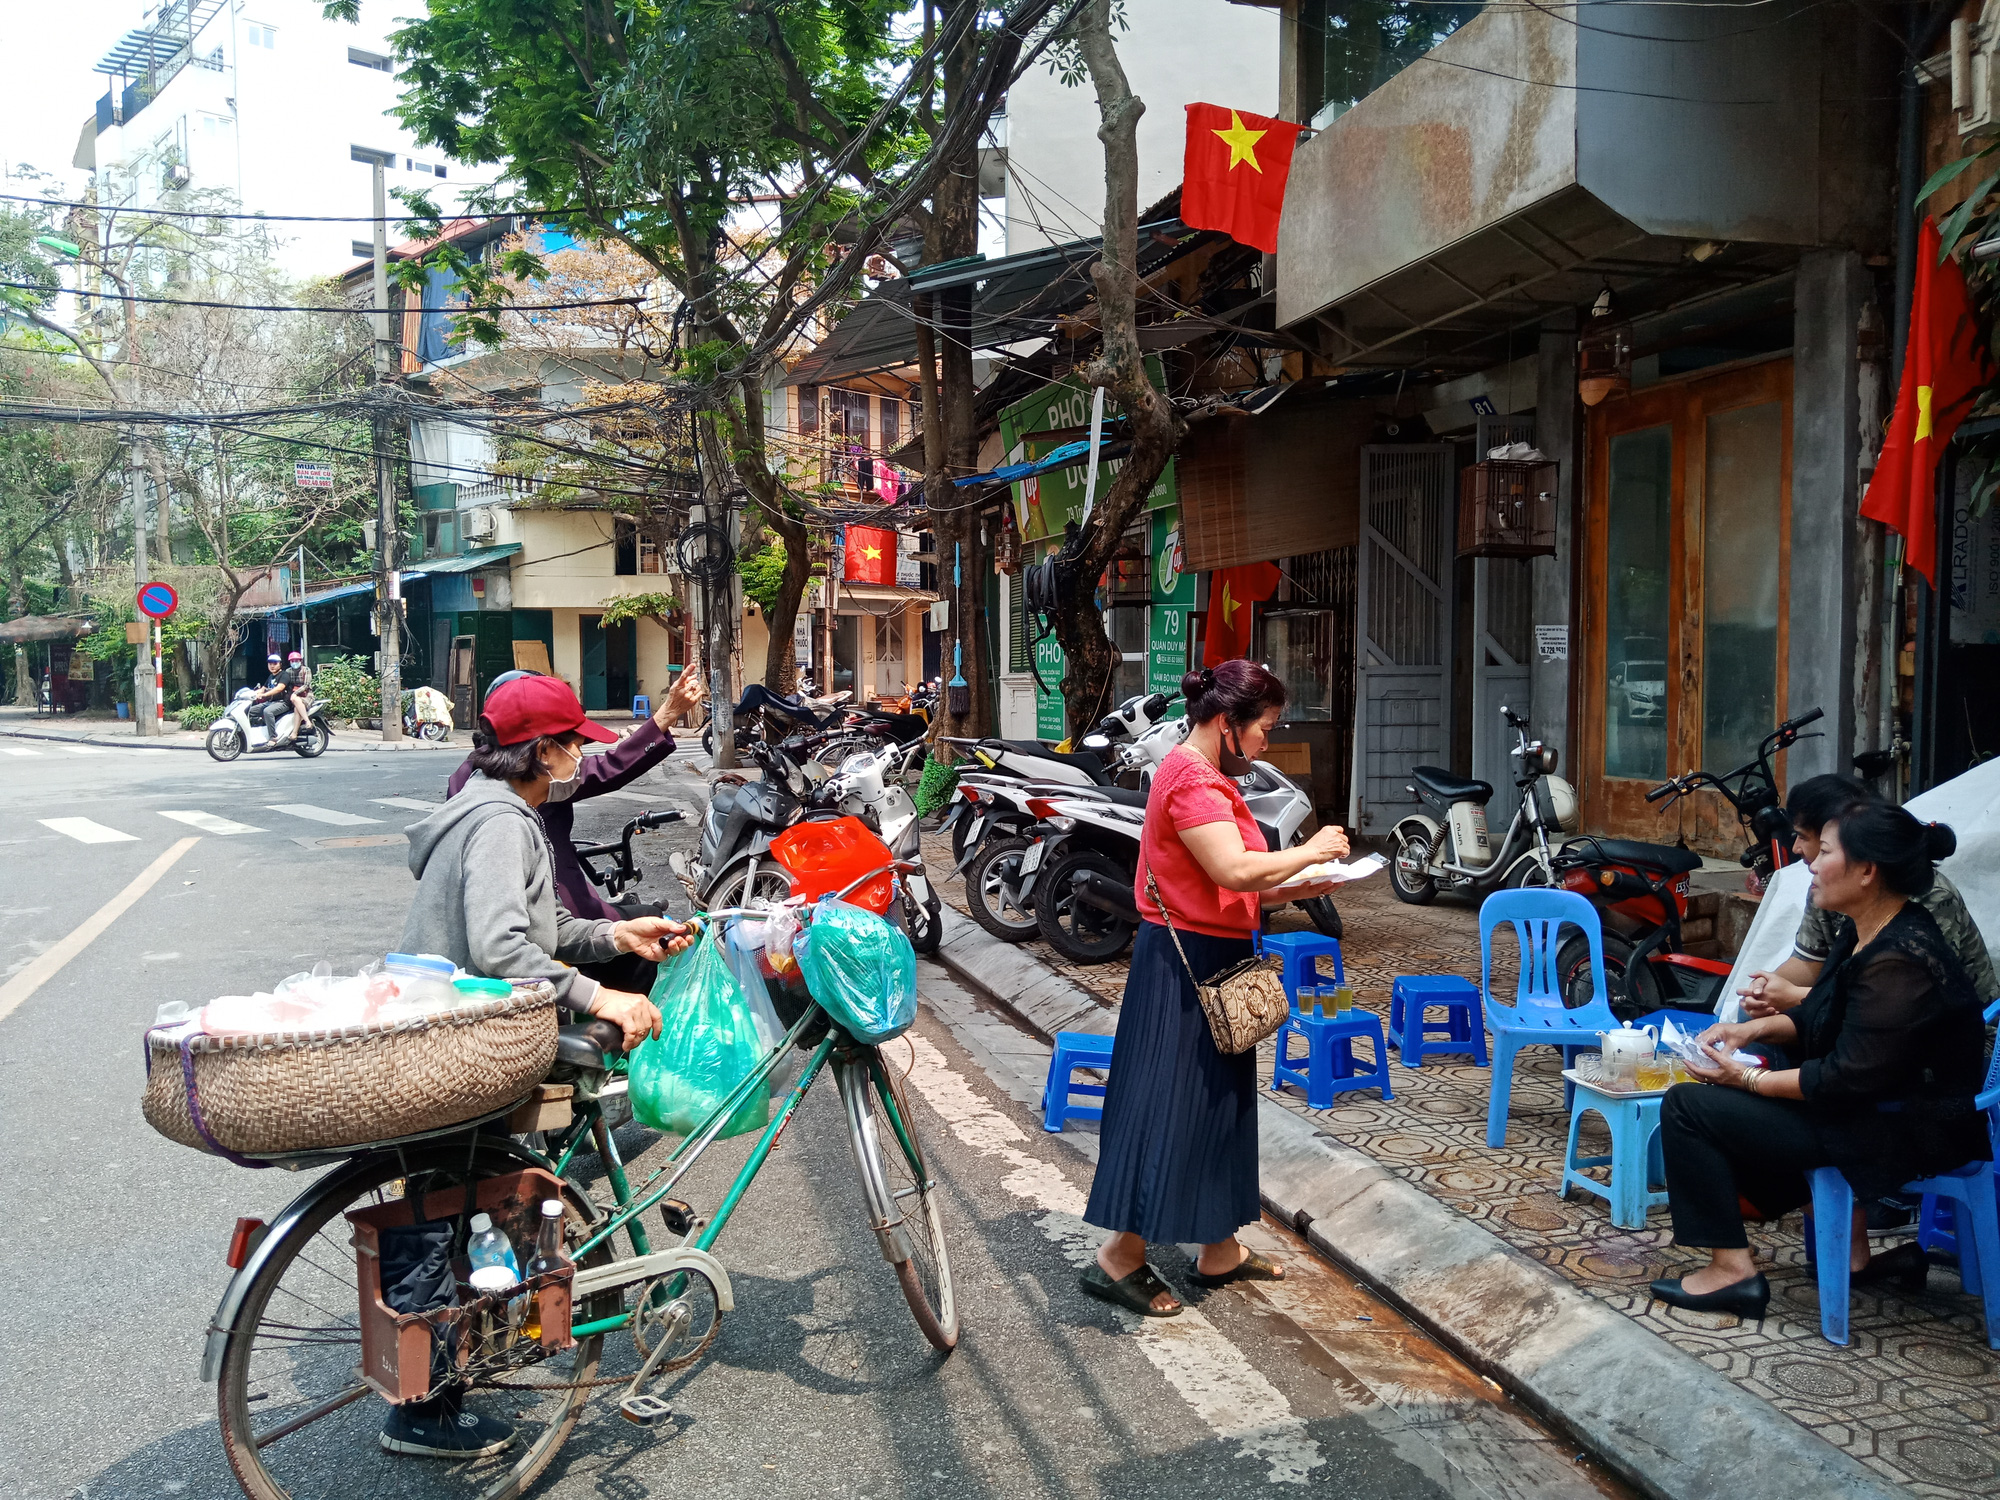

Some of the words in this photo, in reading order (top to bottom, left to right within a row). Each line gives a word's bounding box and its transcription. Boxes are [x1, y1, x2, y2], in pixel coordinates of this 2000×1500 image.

[1475, 401, 1492, 415] 81
[1164, 610, 1179, 635] 79
[1167, 641, 1178, 651] DUY
